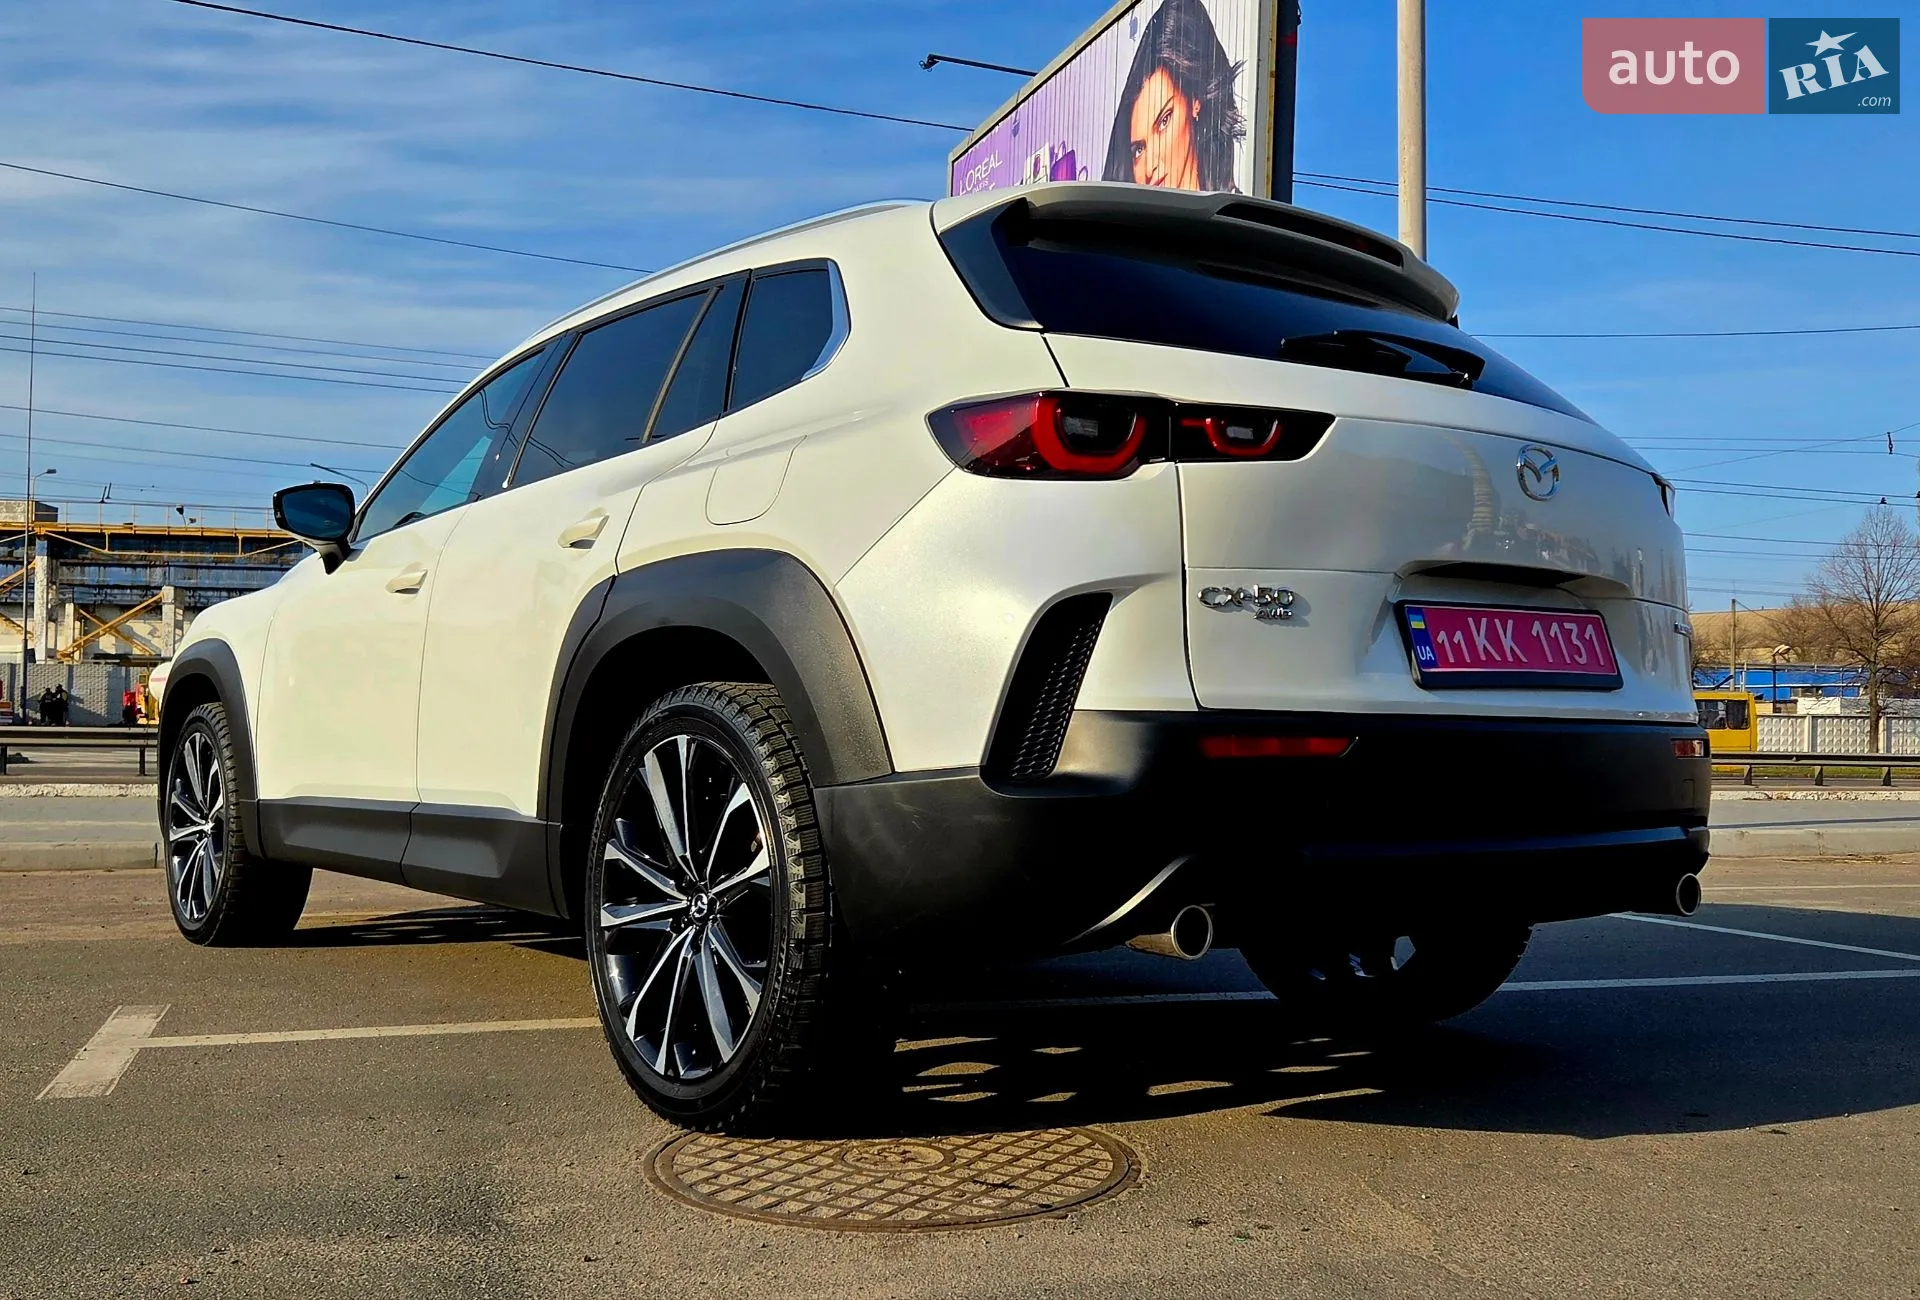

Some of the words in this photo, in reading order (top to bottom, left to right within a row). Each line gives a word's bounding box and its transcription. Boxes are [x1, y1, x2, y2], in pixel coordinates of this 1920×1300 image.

[1197, 584, 1295, 608] CX-50
[1417, 645, 1435, 661] UA
[1531, 620, 1605, 666] 1131
